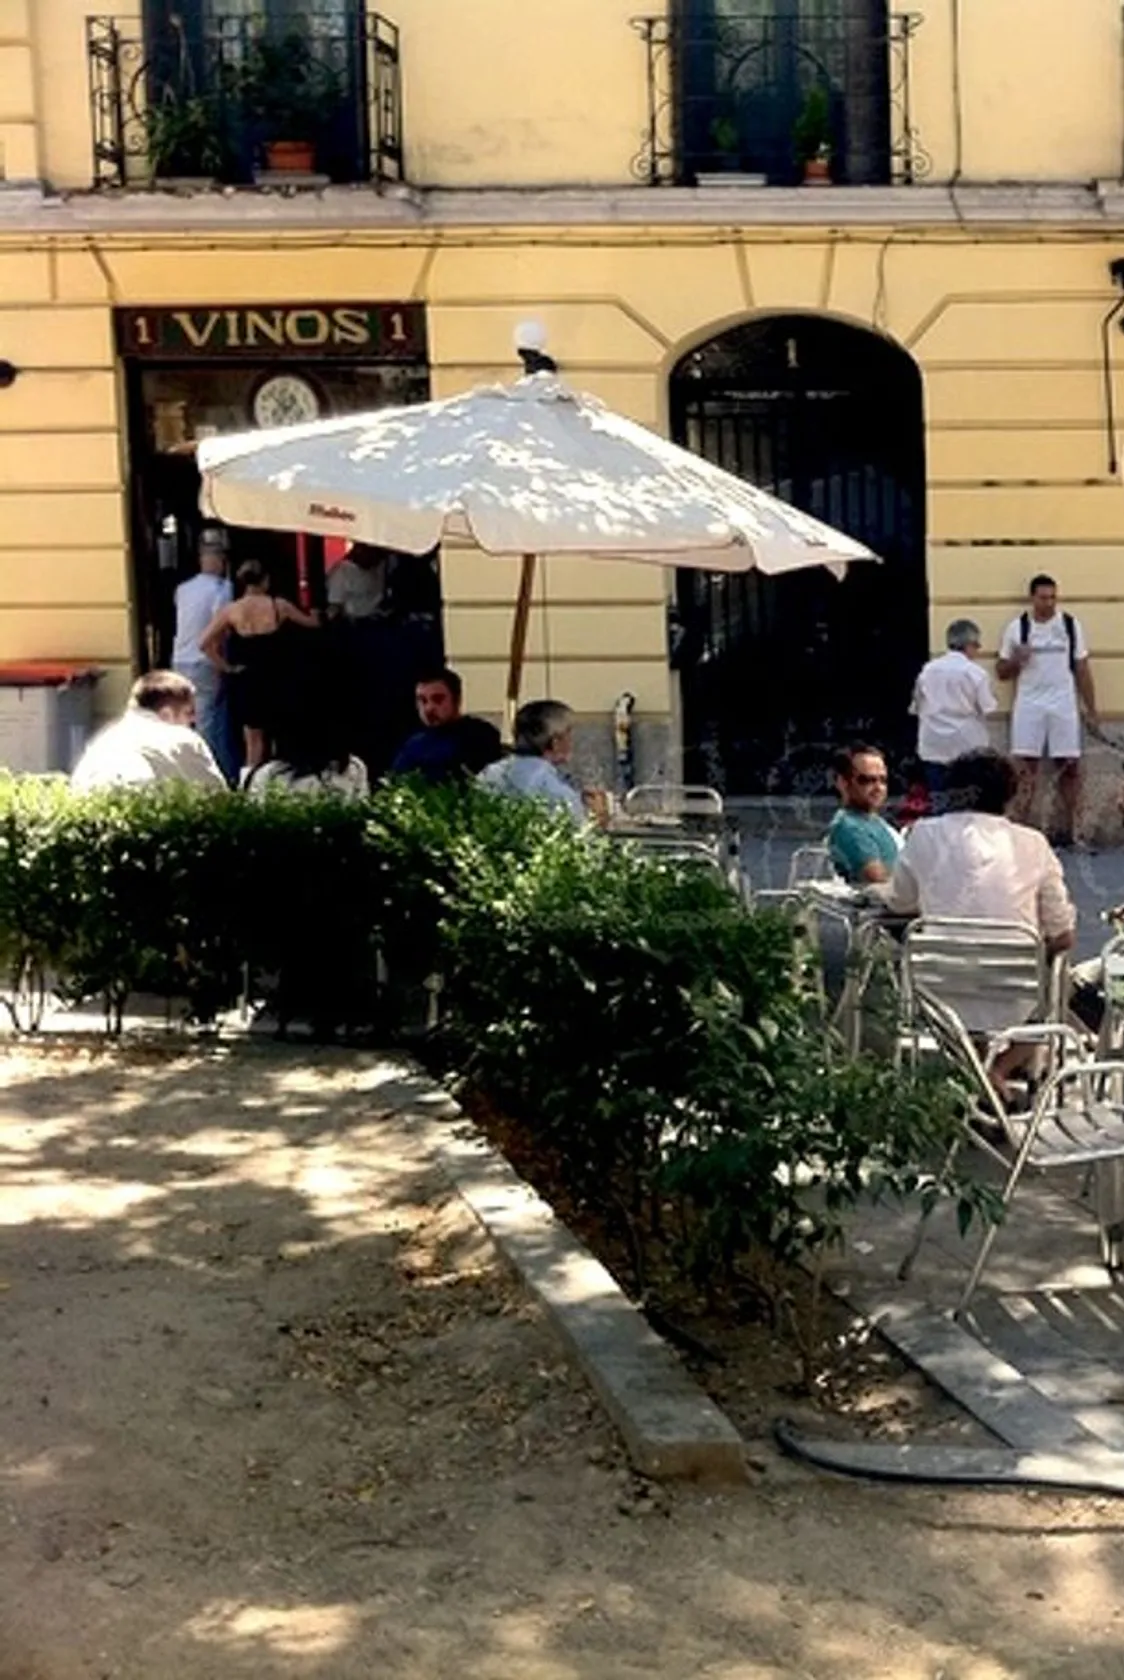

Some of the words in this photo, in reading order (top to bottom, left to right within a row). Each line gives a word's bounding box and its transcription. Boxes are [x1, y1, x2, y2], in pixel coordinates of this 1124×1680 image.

[135, 317, 151, 343] 1
[172, 309, 371, 347] VINOS
[391, 313, 406, 340] 1
